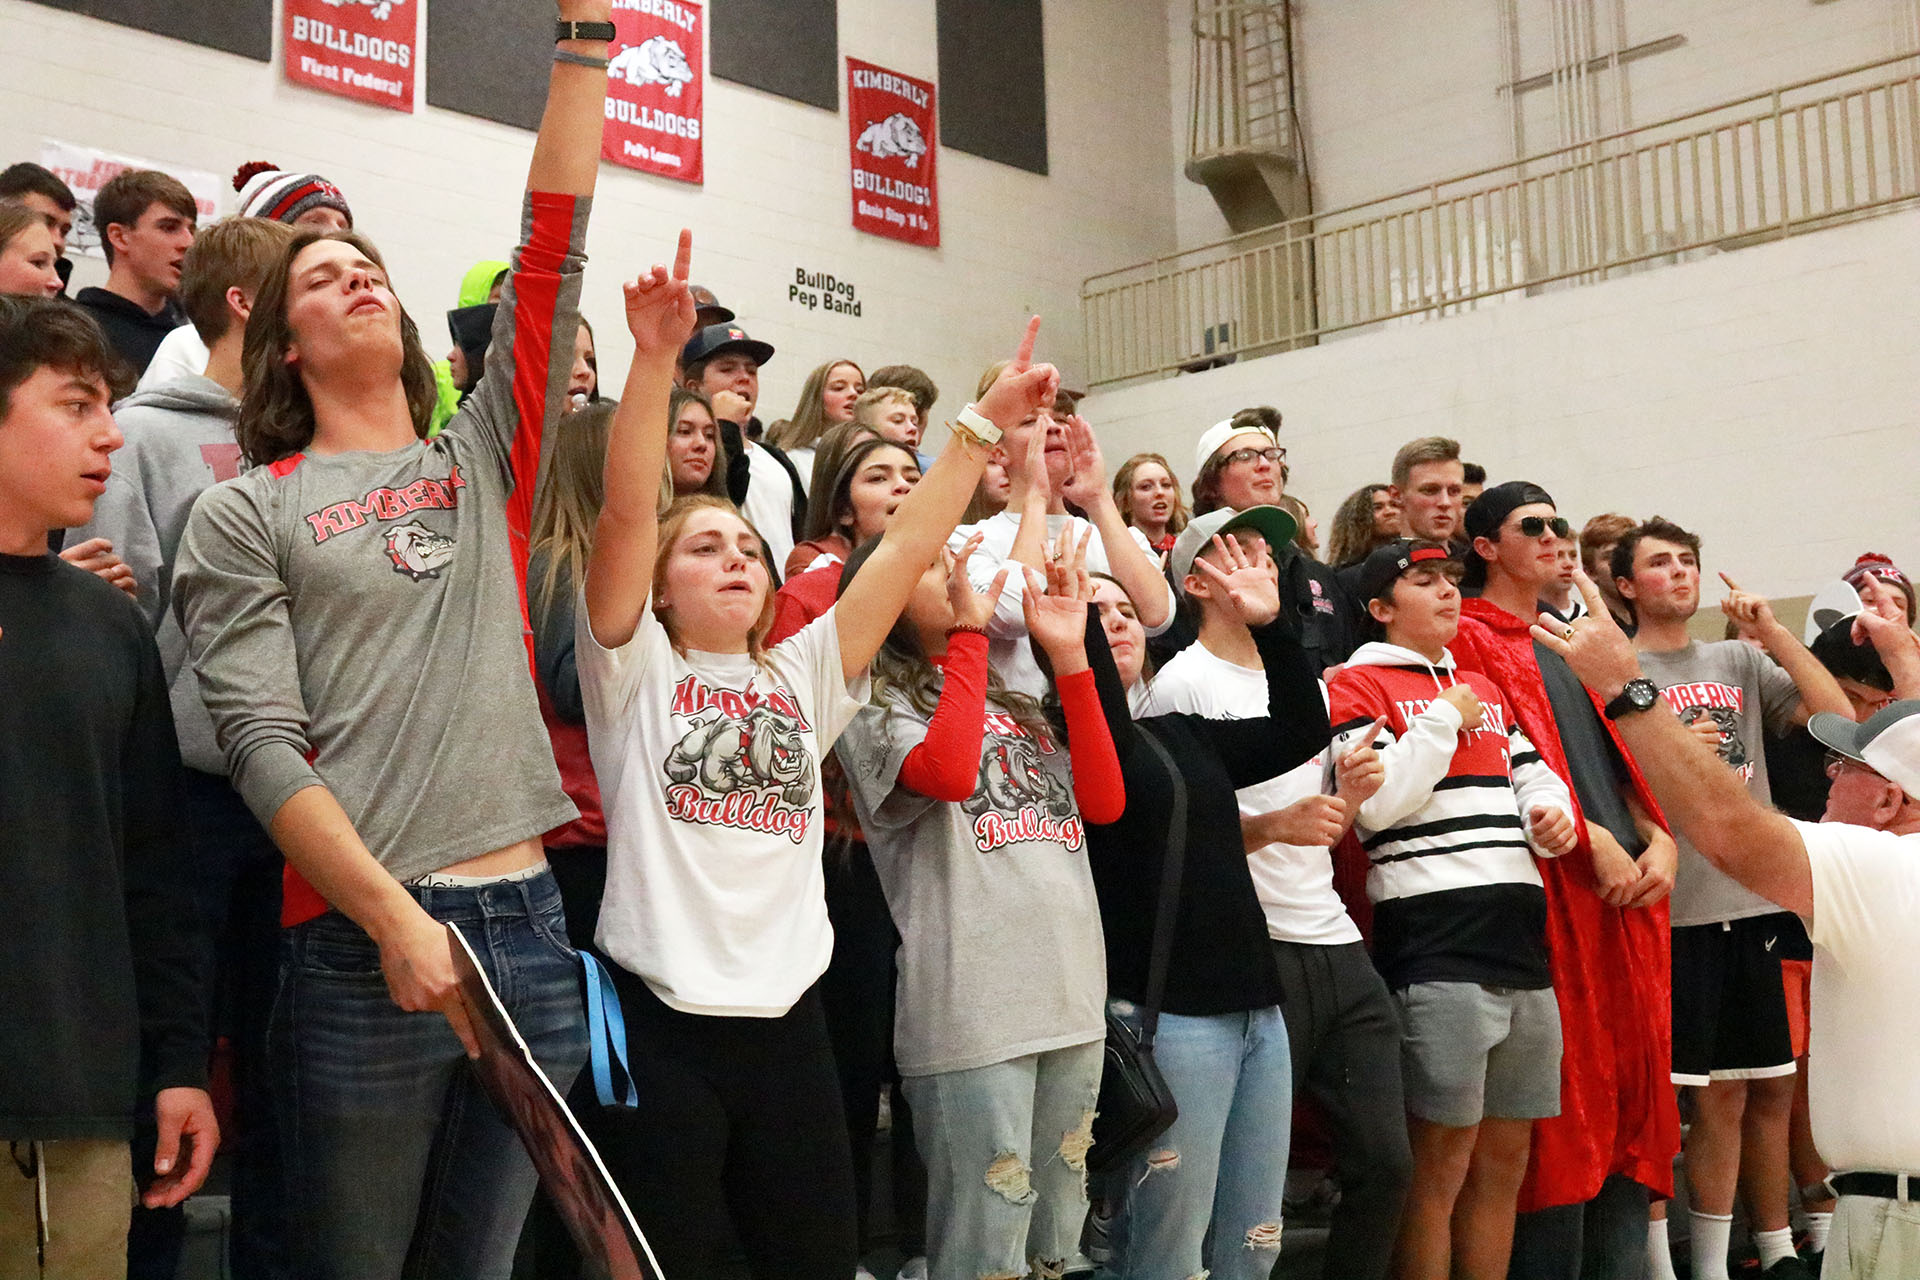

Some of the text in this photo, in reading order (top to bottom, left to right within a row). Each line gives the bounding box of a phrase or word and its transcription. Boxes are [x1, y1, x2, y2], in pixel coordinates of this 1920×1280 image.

[292, 15, 411, 69] BULLDOGS
[301, 56, 403, 97] First Federal
[853, 69, 929, 109] KIMBERLY
[604, 96, 700, 140] BULLDOGS
[853, 168, 931, 206] BULLDOGS
[789, 285, 862, 317] Pep Band
[796, 267, 855, 301] BullDog
